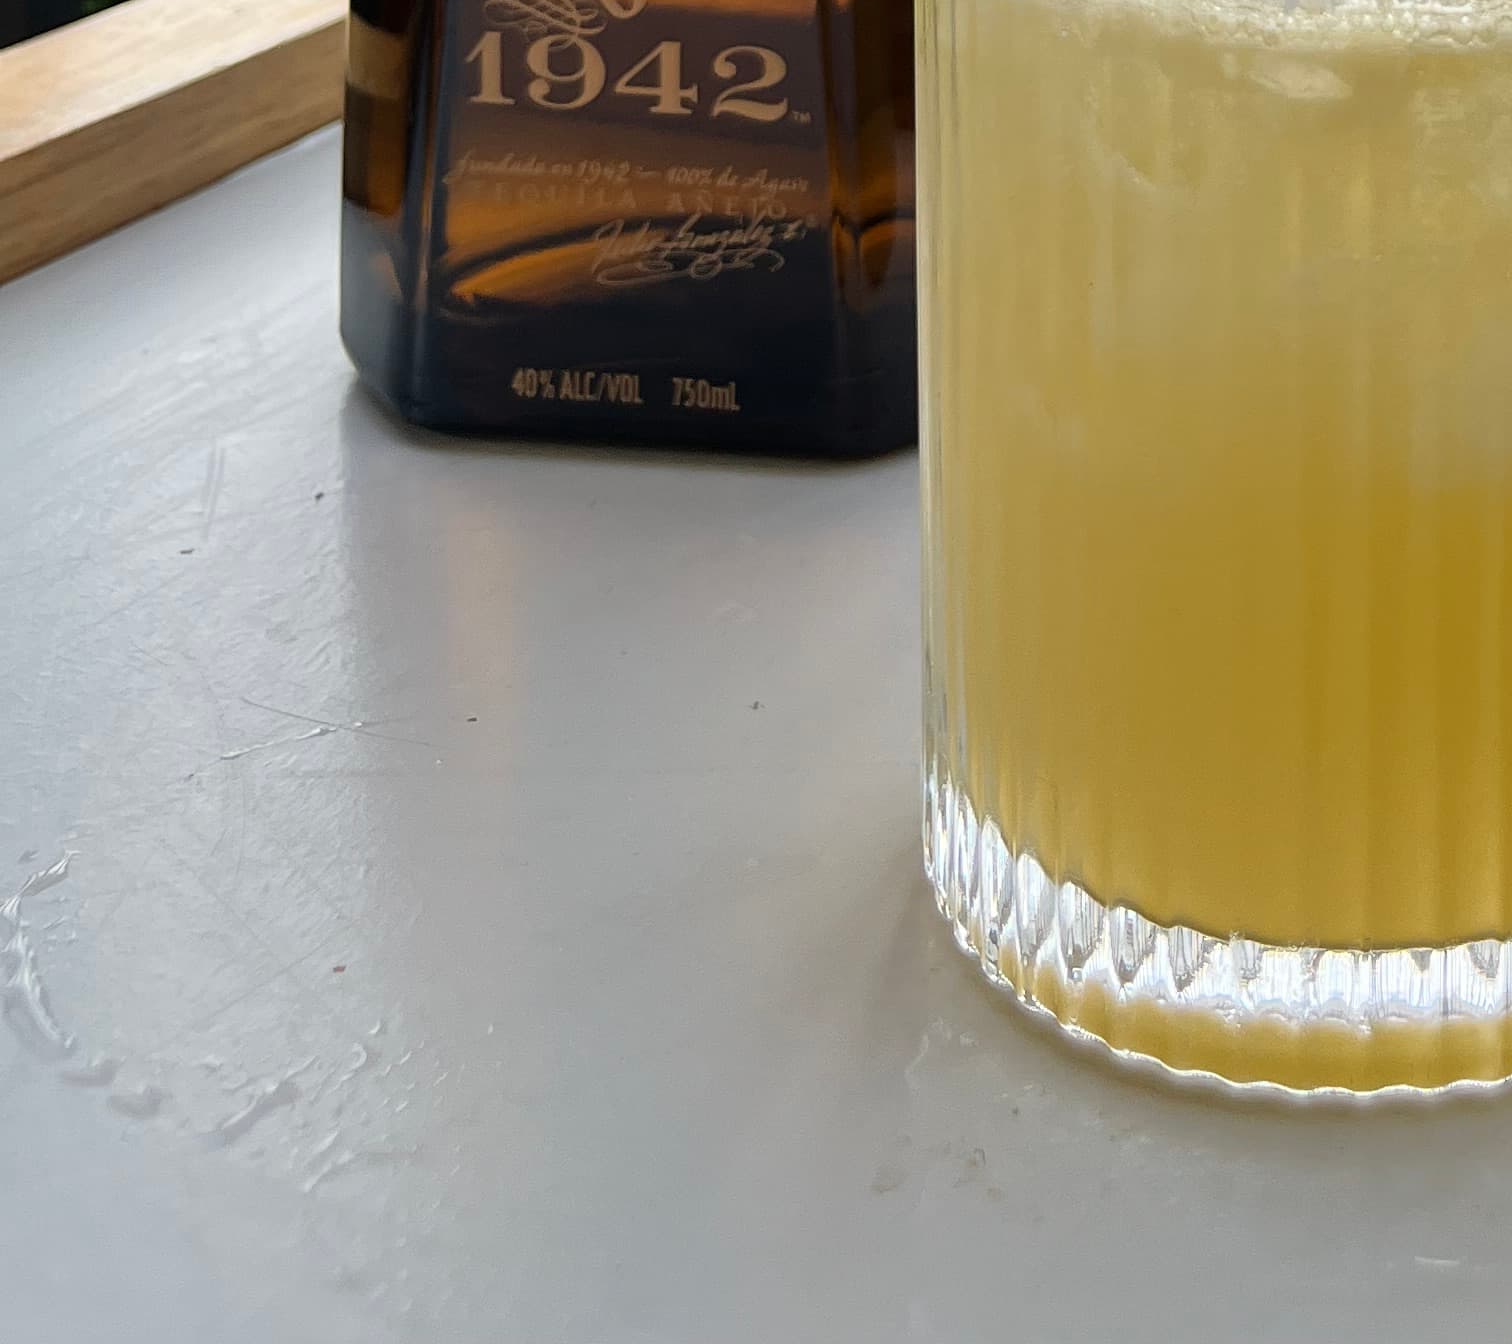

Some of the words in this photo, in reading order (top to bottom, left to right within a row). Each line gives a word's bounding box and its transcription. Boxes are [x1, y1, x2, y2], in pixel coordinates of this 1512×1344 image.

[464, 30, 789, 121] 1942
[576, 159, 633, 186] 1942
[511, 368, 555, 399] 40%
[559, 369, 644, 405] ALC/VOL
[672, 377, 741, 411] 750mL
